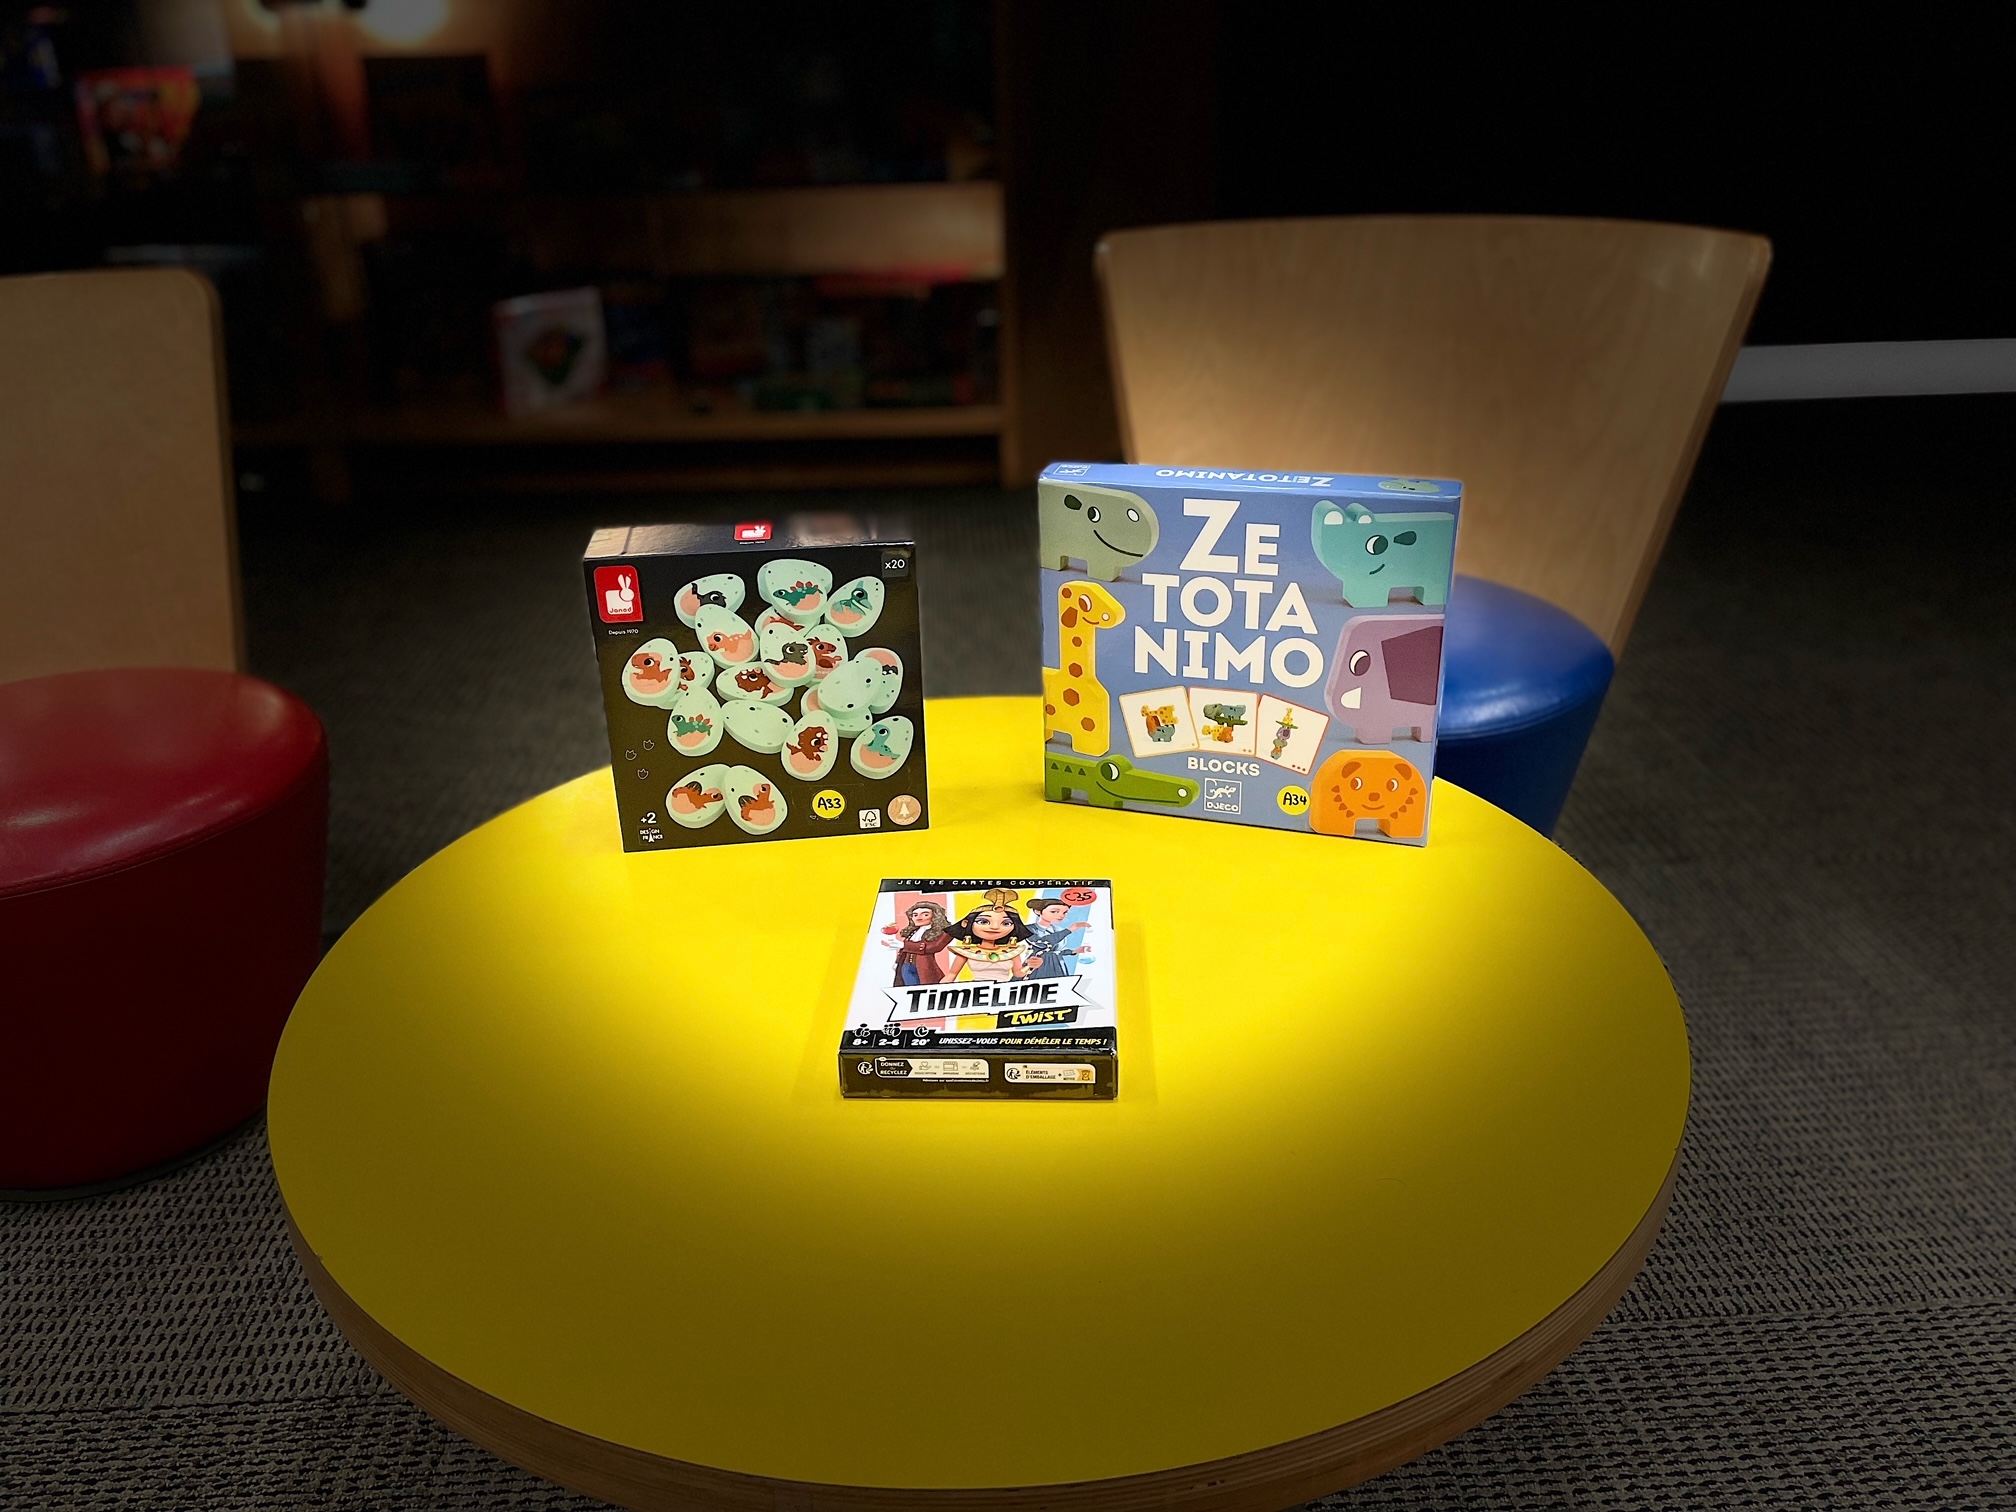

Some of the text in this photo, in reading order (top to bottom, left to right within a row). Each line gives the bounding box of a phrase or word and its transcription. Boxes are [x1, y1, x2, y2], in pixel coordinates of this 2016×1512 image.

[1179, 498, 1280, 576] ZE
[884, 559, 905, 569] x20
[1142, 573, 1319, 635] TOTA
[1134, 625, 1325, 689] NIMO
[1187, 756, 1261, 777] BLOCKS
[817, 796, 842, 811] A33
[1282, 792, 1308, 806] A34
[1206, 801, 1239, 812] DJECO
[640, 812, 657, 824] +2
[1064, 891, 1093, 902] C35
[852, 1038, 869, 1046] 8+
[938, 1037, 998, 1045] UNISSEZ-VOUS
[1024, 1036, 1061, 1045] DÉMÊLER
